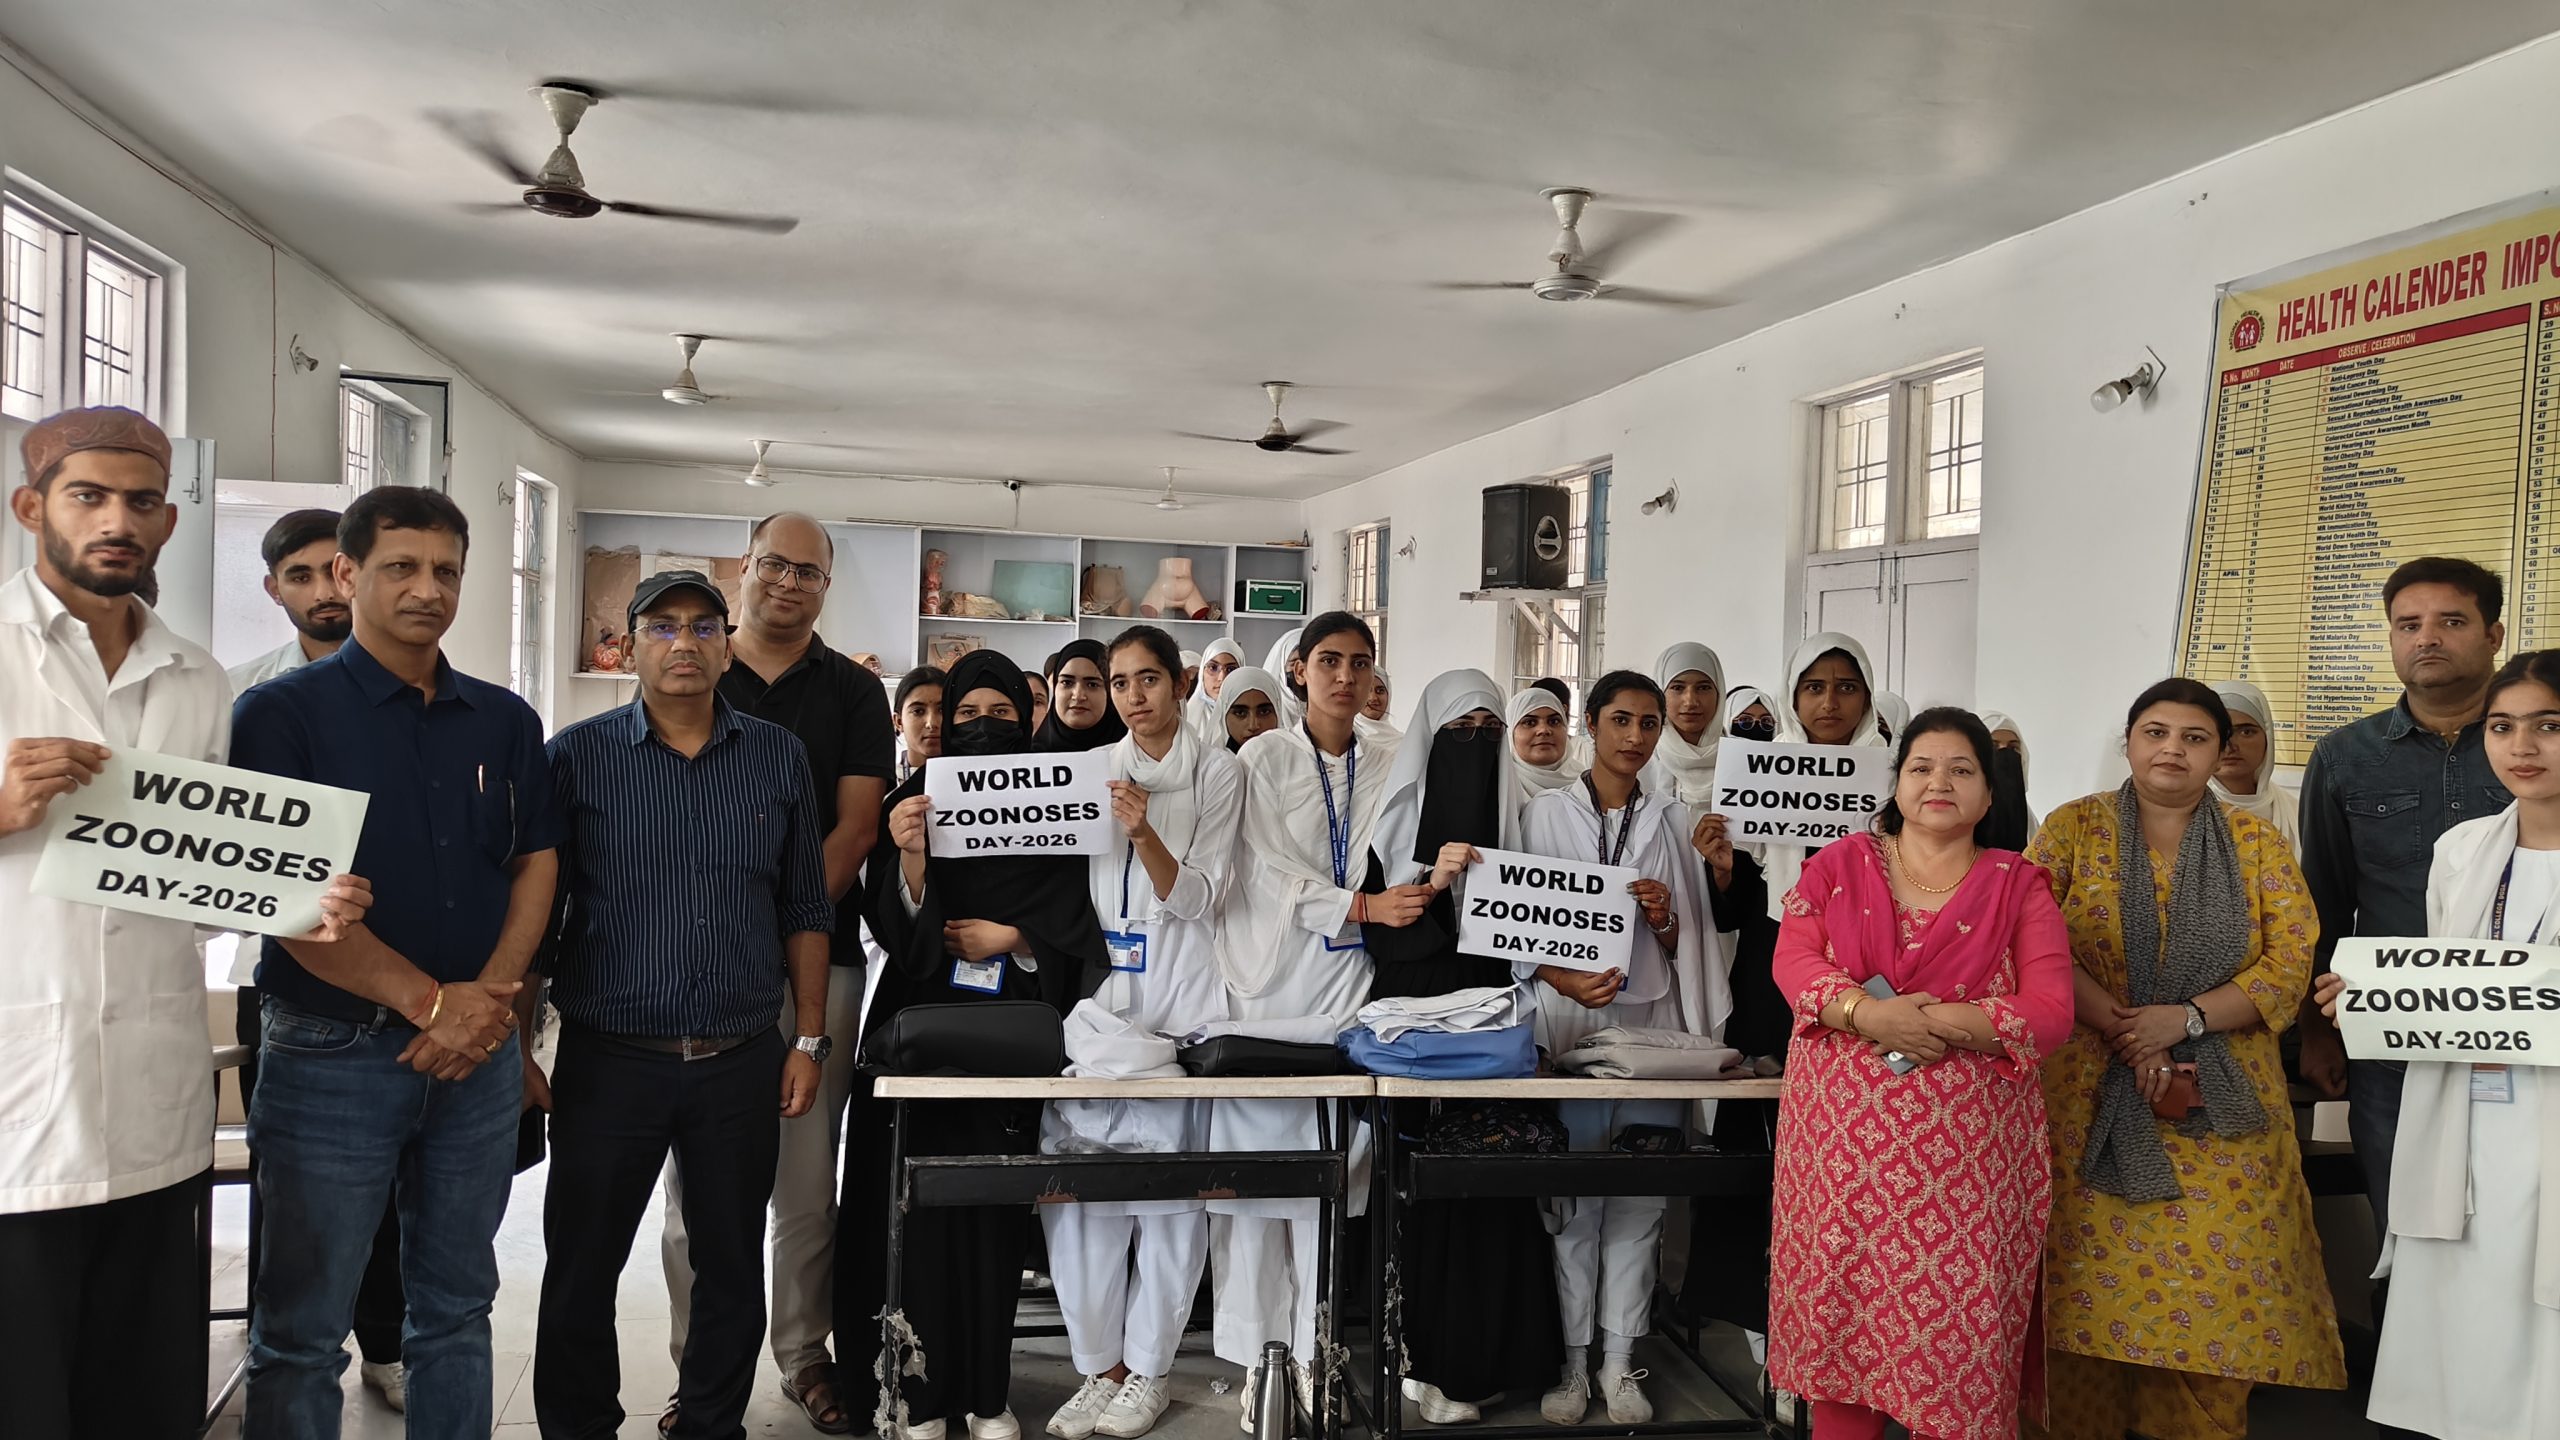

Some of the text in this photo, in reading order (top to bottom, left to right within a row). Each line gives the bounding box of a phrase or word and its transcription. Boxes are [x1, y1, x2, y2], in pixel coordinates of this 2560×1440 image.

[2277, 284, 2358, 343] HEALTH
[2363, 250, 2487, 322] CALENDER
[2339, 332, 2416, 358] OBSERVE CELEBRATION
[2241, 367, 2260, 380] MONTH
[2280, 360, 2294, 371] DATE
[2331, 362, 2354, 372] National
[2328, 400, 2363, 412] International
[2329, 392, 2352, 402] National
[2392, 402, 2412, 410] Health
[2414, 396, 2448, 407] Awareness
[2326, 421, 2361, 432] International
[2377, 423, 2409, 433] Awareness
[2322, 472, 2357, 481] International
[2360, 477, 2392, 486] Awareness
[1748, 754, 1855, 777] WORLD
[958, 766, 1072, 792] WORLD
[132, 770, 310, 827] WORLD
[1720, 788, 1876, 812] ZOONOSES
[936, 802, 1099, 826] ZOONOSES
[1744, 821, 1849, 838] DAY-2026
[65, 814, 331, 882] ZOONOSES
[966, 834, 1077, 849] DAY-2026
[1500, 864, 1604, 894] WORLD
[97, 870, 278, 917] DAY-2026
[1471, 898, 1624, 933] ZOONOSES
[1493, 934, 1598, 960] DAY-2026
[2376, 949, 2529, 968] WORLD
[2346, 986, 2560, 1013] ZOONOSES
[2383, 1031, 2532, 1050] DAY-2026
